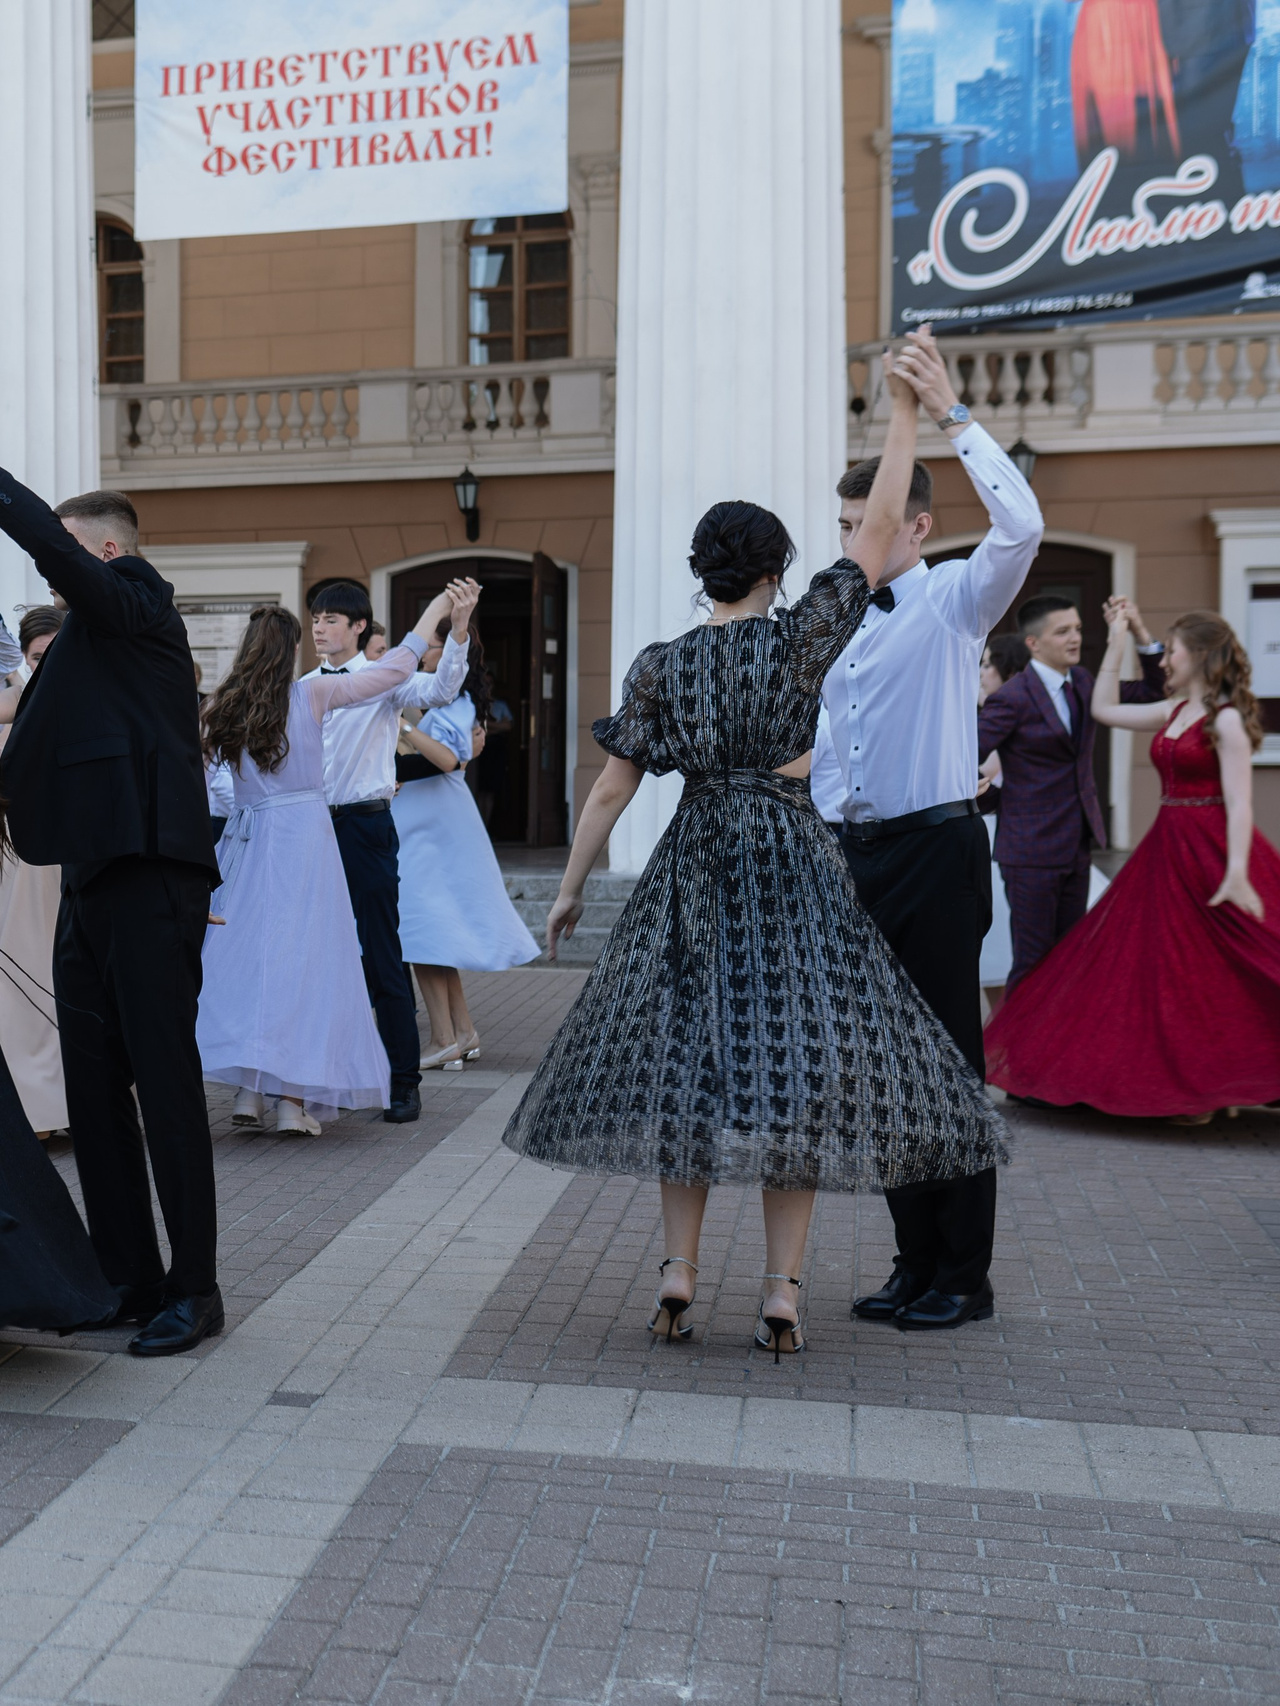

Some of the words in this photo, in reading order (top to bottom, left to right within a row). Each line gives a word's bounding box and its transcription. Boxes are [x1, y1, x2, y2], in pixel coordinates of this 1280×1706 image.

[159, 32, 540, 97] ПРИВЕТСТВУЕМ
[196, 79, 500, 146] УЧАСТНИКОВ
[202, 120, 494, 177] ФЕСТИВАЛЯ!
